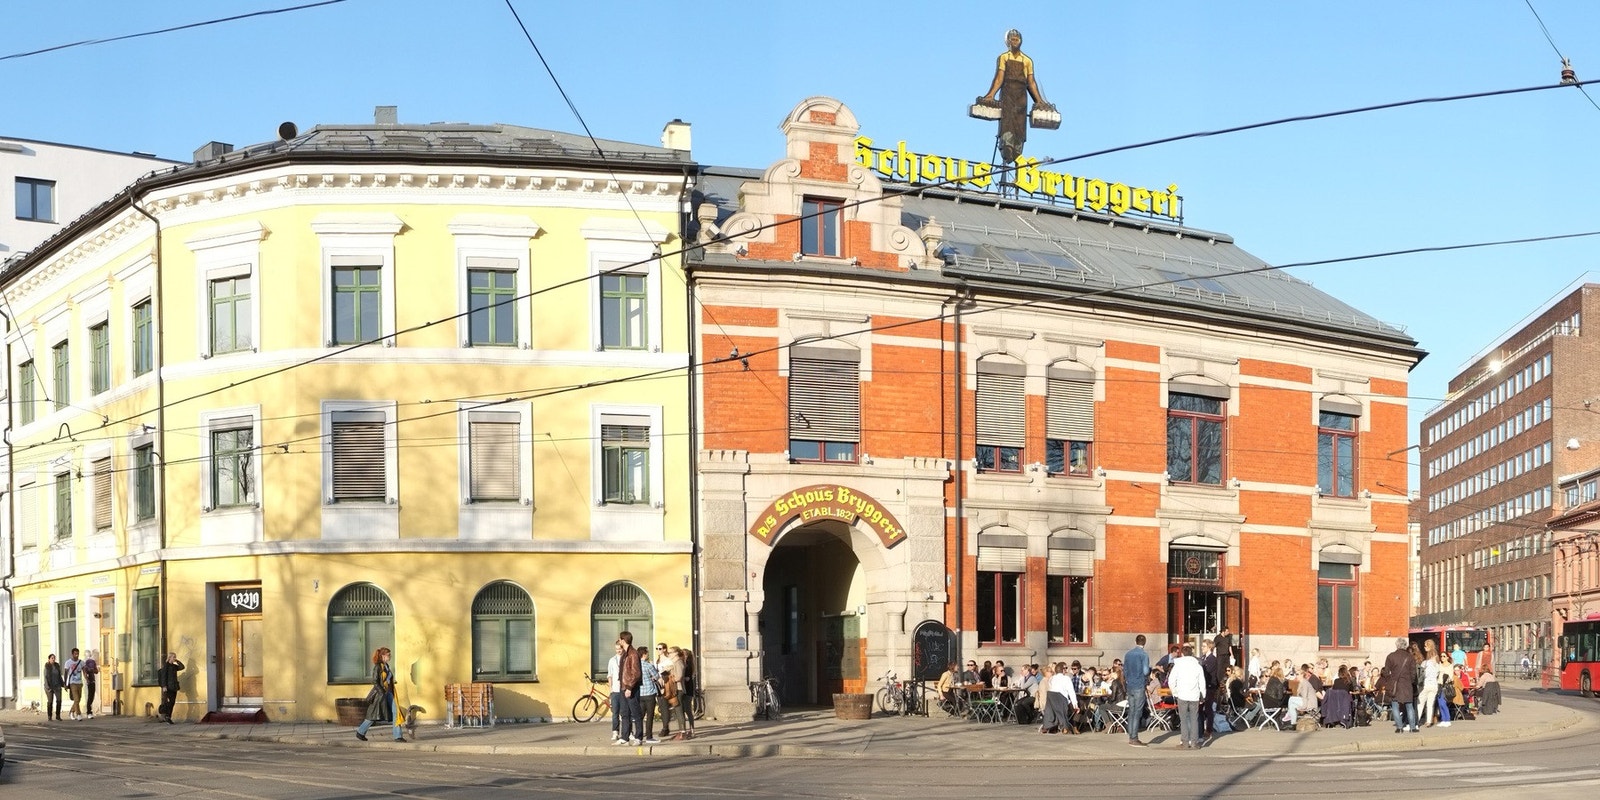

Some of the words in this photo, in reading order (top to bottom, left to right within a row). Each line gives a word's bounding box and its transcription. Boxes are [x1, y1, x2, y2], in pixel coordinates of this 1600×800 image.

[853, 134, 993, 189] Schous
[1014, 154, 1179, 218] Bryggeri
[757, 514, 778, 538] A/S
[774, 488, 834, 517] Schous
[837, 486, 903, 540] Bryggeri
